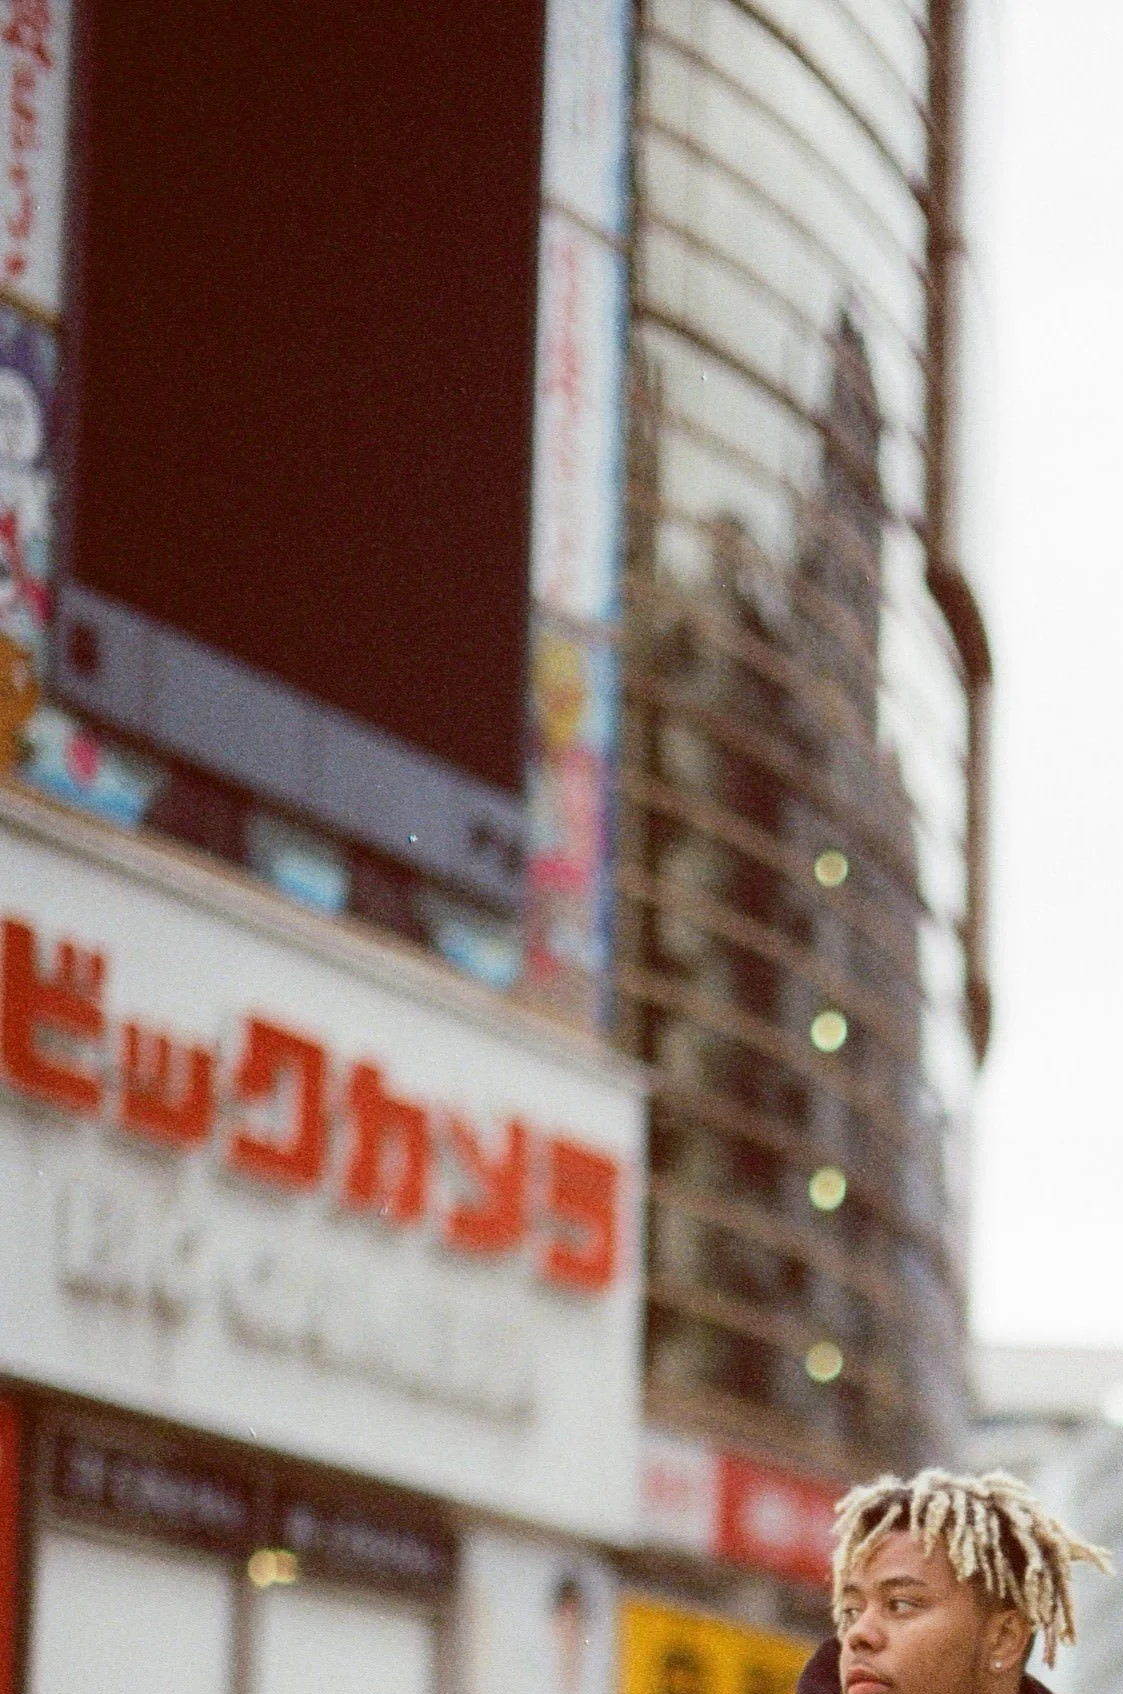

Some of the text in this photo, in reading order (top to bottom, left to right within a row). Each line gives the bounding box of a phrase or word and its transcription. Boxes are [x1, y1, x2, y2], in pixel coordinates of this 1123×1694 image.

[1, 916, 620, 1292] ビックカメラ
